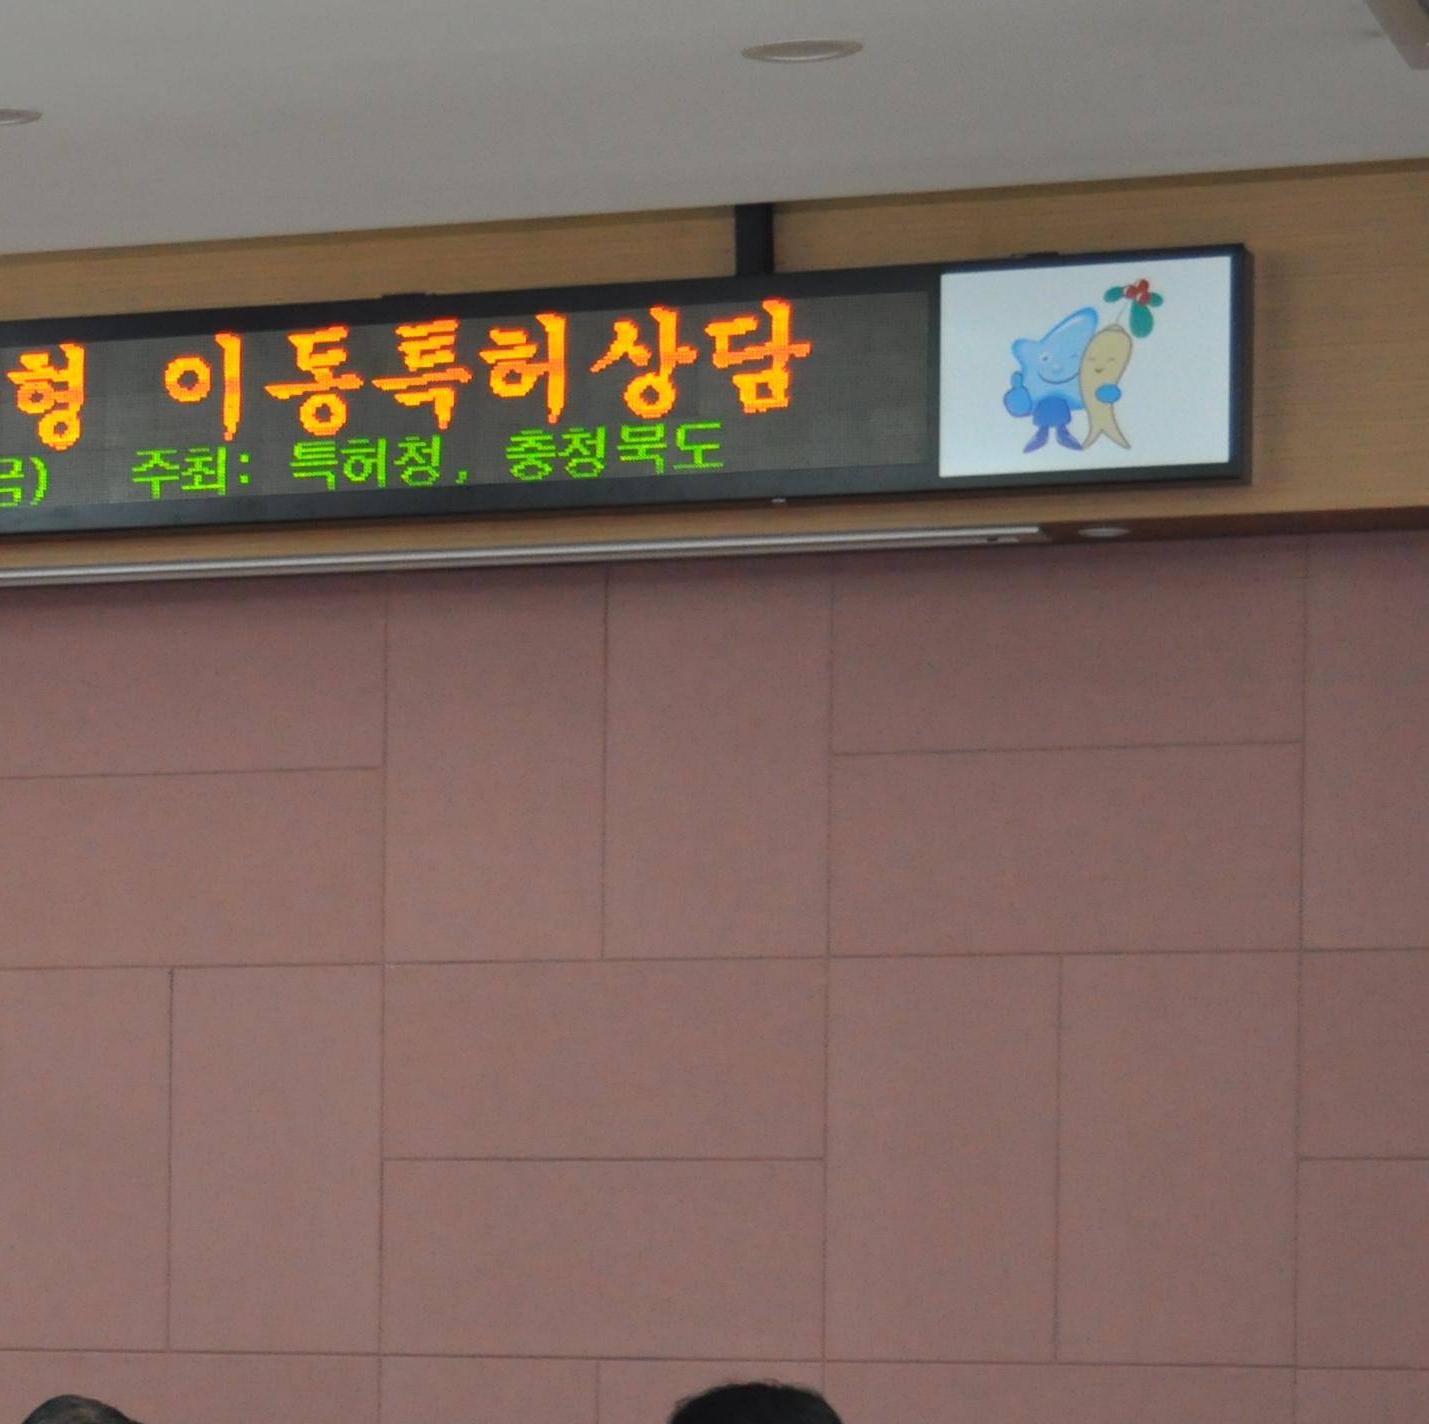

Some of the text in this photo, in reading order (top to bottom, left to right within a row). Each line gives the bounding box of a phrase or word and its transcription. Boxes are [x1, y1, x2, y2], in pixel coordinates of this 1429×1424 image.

[164, 299, 812, 442] 이동특허상담
[132, 446, 250, 499] 주최:
[290, 435, 468, 490] 특허청,
[506, 422, 723, 480] 충청북도
